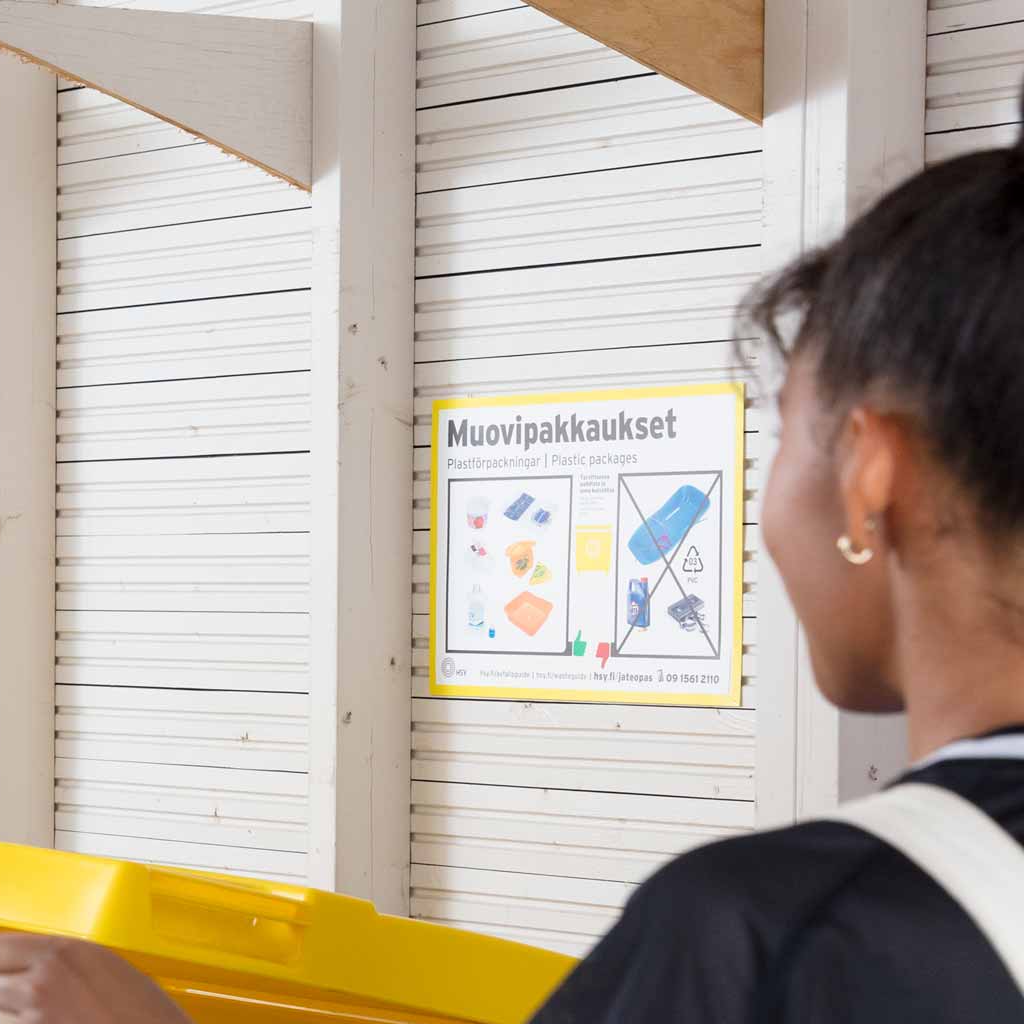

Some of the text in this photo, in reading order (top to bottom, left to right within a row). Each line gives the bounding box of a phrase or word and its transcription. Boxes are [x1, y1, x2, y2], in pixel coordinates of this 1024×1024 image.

[448, 408, 676, 451] Muovipakkaukset
[448, 452, 638, 470] Plastförpackningar Plastic packages
[666, 673, 678, 682] 09
[680, 674, 699, 683] 1561
[700, 675, 720, 684] 2110
